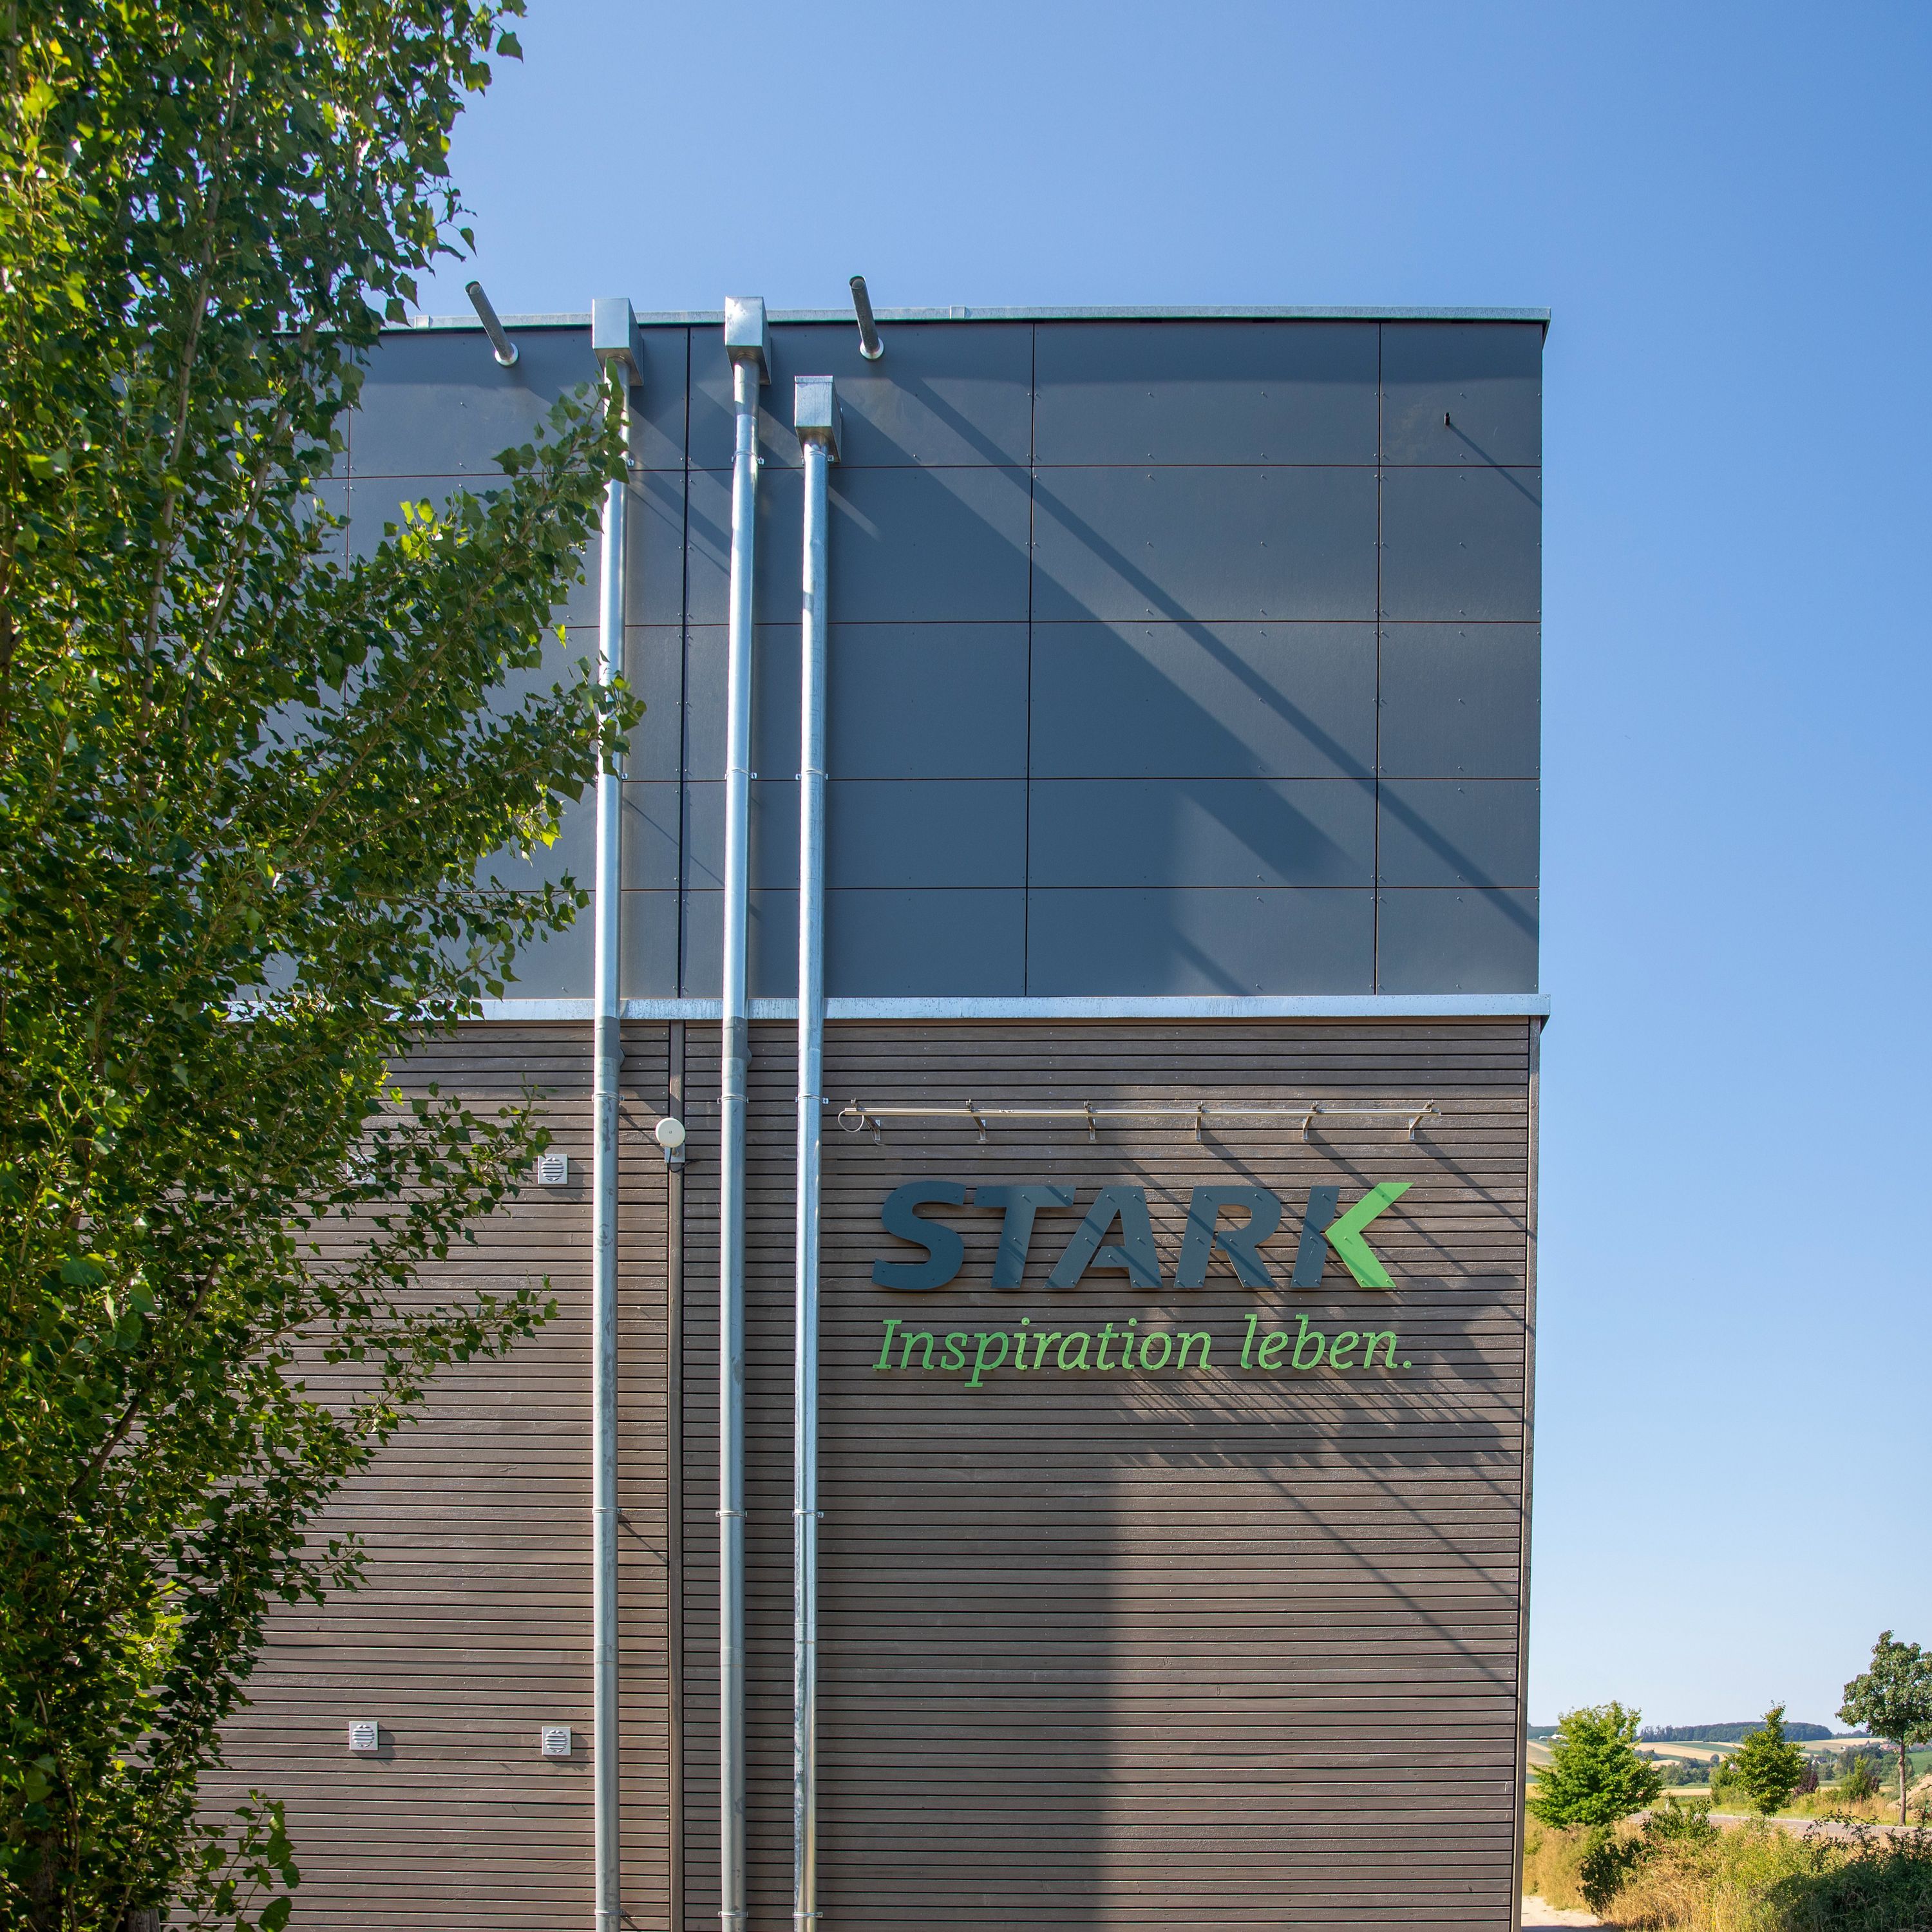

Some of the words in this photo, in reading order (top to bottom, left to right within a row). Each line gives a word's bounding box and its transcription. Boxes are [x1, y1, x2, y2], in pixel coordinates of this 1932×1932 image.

[872, 1182, 1414, 1289] STARK
[873, 1318, 1212, 1387] Inspiration
[1241, 1314, 1412, 1370] leben.
